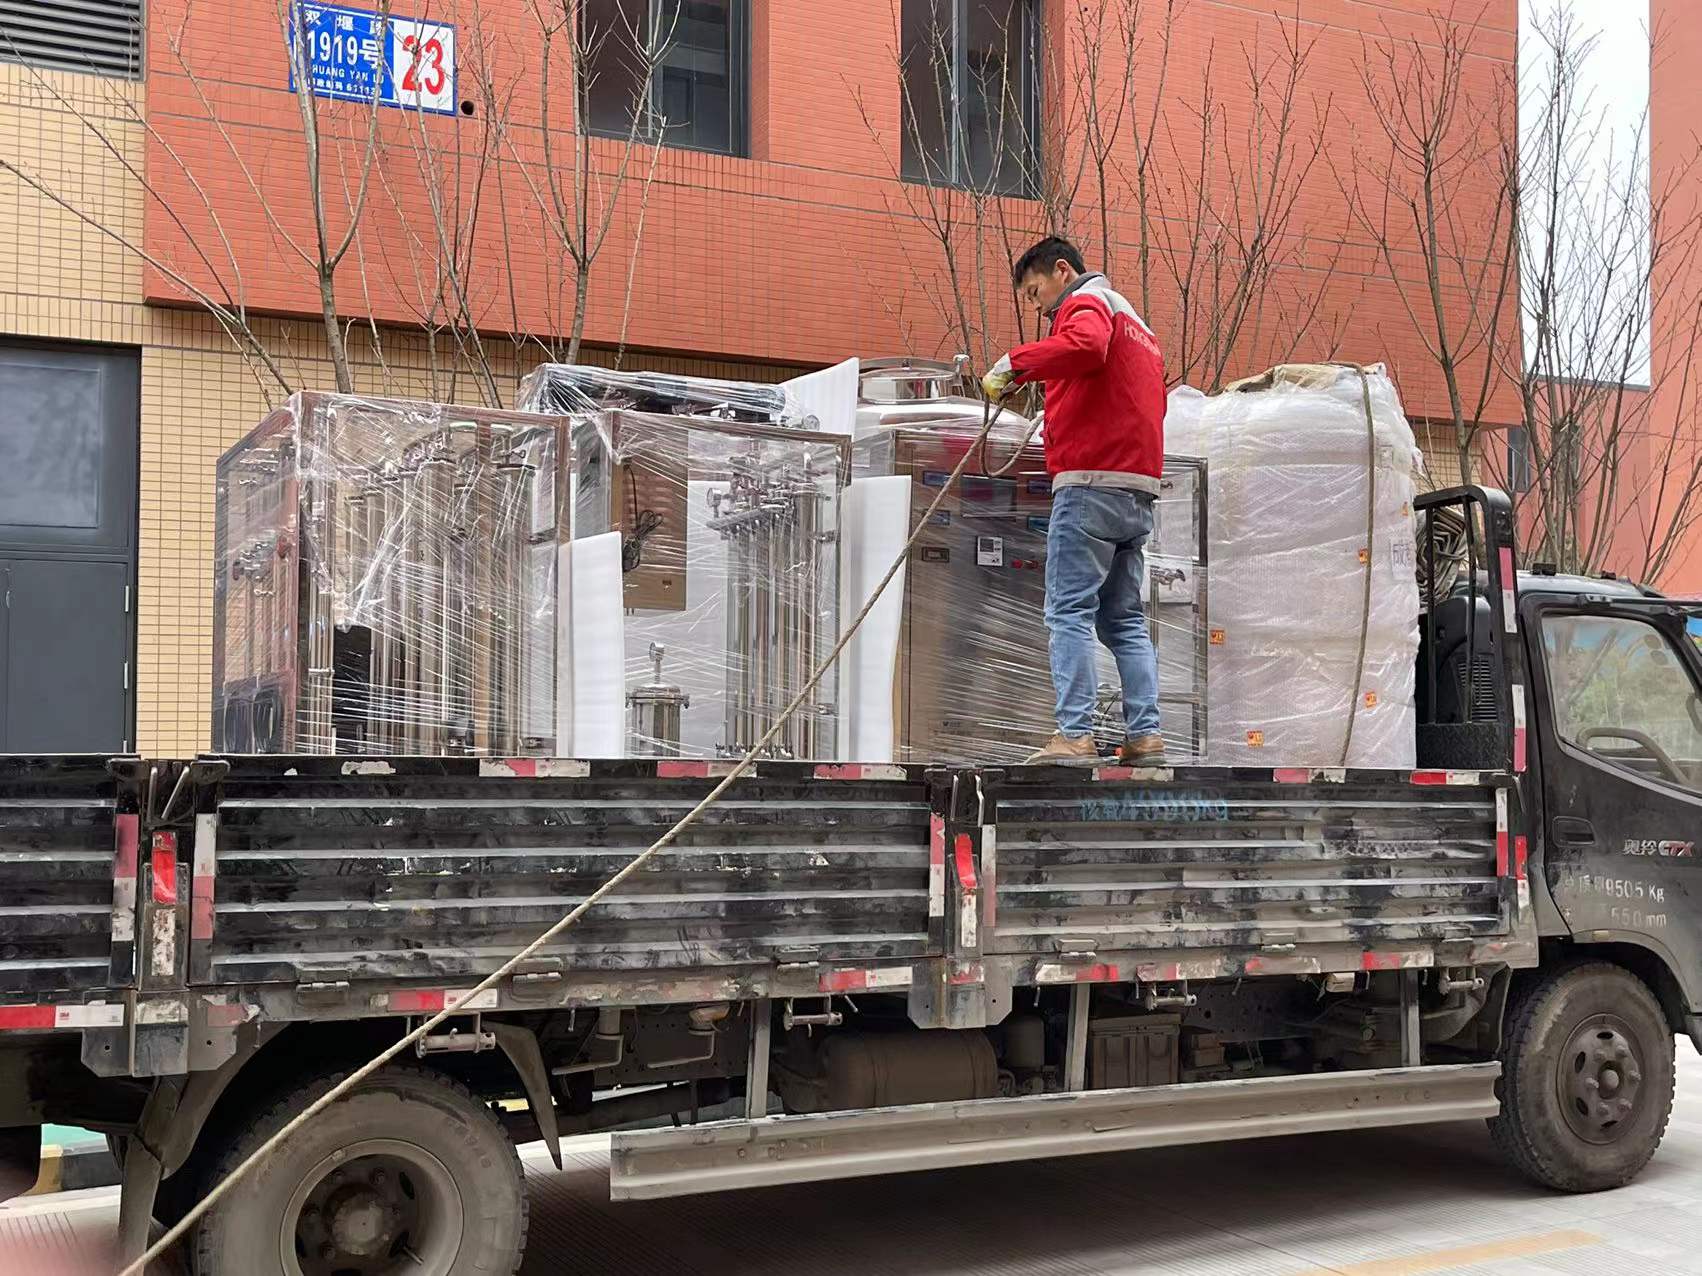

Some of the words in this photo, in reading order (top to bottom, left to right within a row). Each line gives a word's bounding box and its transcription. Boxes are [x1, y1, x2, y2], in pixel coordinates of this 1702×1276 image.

[309, 64, 345, 78] HUANG
[350, 70, 368, 82] YAN
[402, 35, 445, 95] 23
